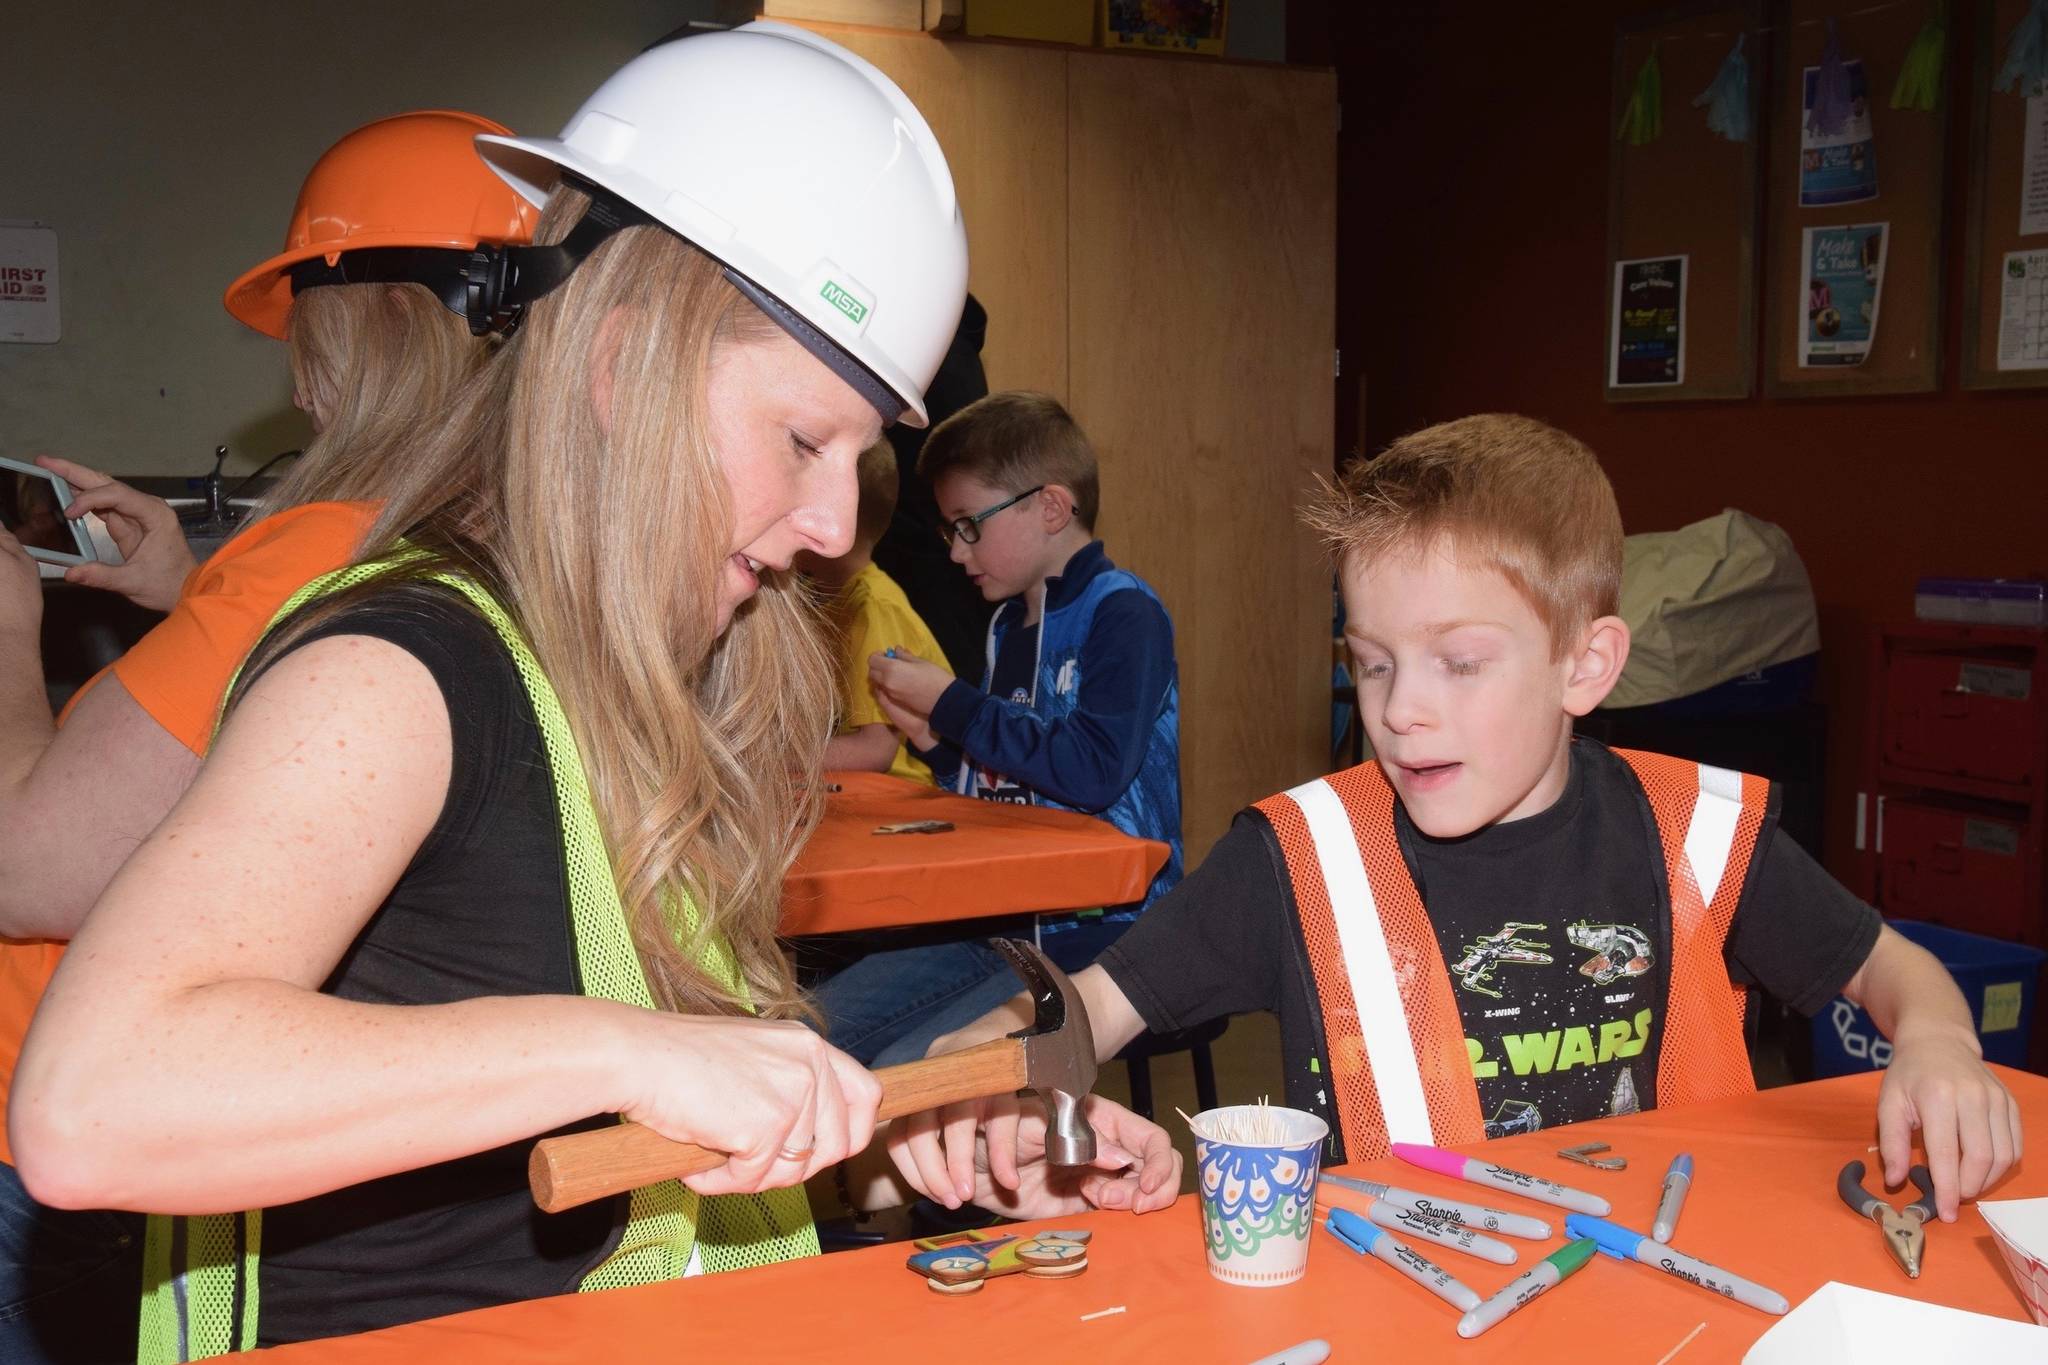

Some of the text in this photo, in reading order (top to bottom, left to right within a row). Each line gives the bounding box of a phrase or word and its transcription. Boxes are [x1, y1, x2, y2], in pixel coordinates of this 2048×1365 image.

[1817, 237, 1856, 257] Make
[0, 267, 46, 281] IRST
[1816, 256, 1858, 272] & Take
[822, 281, 865, 322] MSA
[1484, 1007, 1521, 1018] X-WING
[1502, 1008, 1652, 1076] WARS
[1415, 1200, 1465, 1223] Sharpie
[1402, 1219, 1441, 1237] Permanent Marker
[1661, 1258, 1702, 1286] Sharpie
